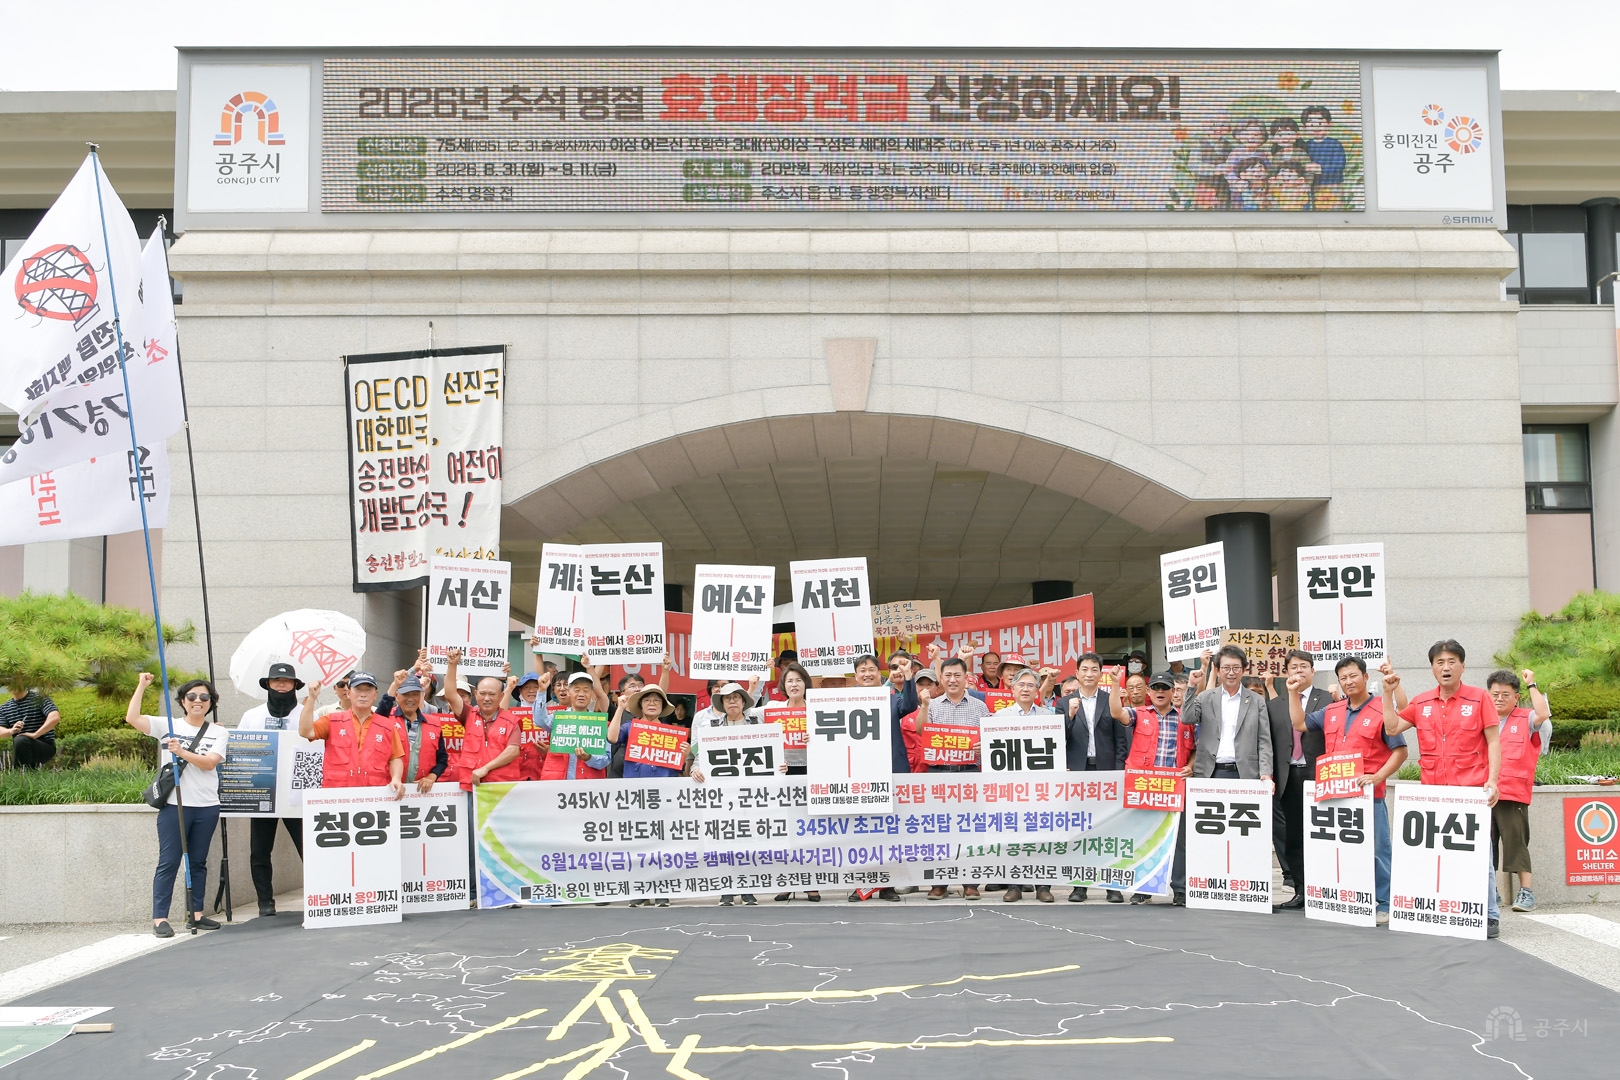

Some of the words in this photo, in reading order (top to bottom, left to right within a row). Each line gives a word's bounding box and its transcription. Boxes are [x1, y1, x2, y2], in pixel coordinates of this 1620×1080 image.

[359, 85, 489, 121] 2026년
[498, 84, 566, 121] 추석
[577, 85, 645, 121] 명절
[659, 74, 909, 122] 효행장려금
[924, 74, 1181, 122] 신청하세요!
[610, 138, 637, 152] 이상
[641, 138, 682, 152] 어르신
[904, 138, 945, 152] 세대주
[1382, 133, 1438, 149] 흥미진진
[216, 152, 280, 176] 공주시
[761, 162, 810, 176] 20만원
[1413, 153, 1455, 174] 공주
[217, 177, 256, 186] GONGJU
[354, 375, 429, 413] OECD
[444, 368, 500, 406] 선진국
[358, 453, 430, 493] 송전방식
[447, 445, 503, 485] 여전히
[590, 564, 655, 596] 논산
[1168, 562, 1218, 599] 용인
[1307, 565, 1376, 600] 천안
[436, 578, 502, 610] 서산
[702, 584, 766, 614] 예산
[802, 577, 860, 609] 서천
[1422, 706, 1432, 718] 투
[1460, 704, 1473, 717] 쟁
[556, 724, 576, 735] 충남은
[579, 726, 602, 736] 에너지
[815, 708, 881, 742] 부여
[552, 736, 580, 748] 식민지가
[582, 738, 605, 748] 아니다
[638, 731, 678, 750] 송전탑
[930, 734, 971, 750] 송전탑
[628, 744, 682, 766] 결사반대
[707, 745, 774, 777] 당진
[924, 748, 975, 762] 결사반대
[990, 738, 1057, 772] 해남
[1320, 762, 1356, 781] 송전탑
[810, 782, 849, 794] 해남에서
[851, 782, 890, 794] 용인까지
[1134, 776, 1176, 792] 송전탑
[1316, 779, 1361, 798] 결사반대
[558, 792, 610, 810] 345kV
[615, 790, 662, 810] 신계룡
[676, 788, 724, 808] 신천안
[738, 786, 807, 808] 군산-신천
[893, 786, 926, 804] 전탑
[931, 784, 978, 804] 백지화
[983, 783, 1030, 804] 캠페인
[1036, 782, 1050, 802] 및
[1054, 781, 1118, 801] 기자회견
[811, 796, 832, 805] 이재명
[832, 795, 859, 804] 대통령은
[860, 794, 890, 804] 응답하라!
[1127, 792, 1182, 808] 결사반대
[314, 810, 390, 848] 청양
[582, 821, 613, 842] 용인
[618, 820, 665, 840] 반도체
[669, 820, 700, 840] 산단
[704, 820, 752, 840] 재검토
[756, 819, 788, 838] 하고
[796, 816, 849, 836] 345kV
[854, 815, 900, 835] 초고압
[905, 814, 952, 833] 송전탑
[956, 812, 1018, 832] 건설계획
[1024, 810, 1093, 831] 철회하라!
[1194, 800, 1261, 836] 공주
[1310, 806, 1364, 844] 보령
[1402, 810, 1480, 852] 아산
[541, 850, 633, 872] 8월14일(금)
[637, 849, 698, 870] 7시30분
[703, 845, 843, 868] 캠페인(전막사거리)
[848, 844, 884, 864] 09시
[888, 842, 951, 864] 차량행진
[966, 842, 1002, 858] 11시
[1006, 838, 1068, 857] 공주시청
[1072, 836, 1135, 859] 기자회견
[1576, 848, 1618, 861] 대피소
[566, 883, 590, 898] 용인
[594, 880, 630, 896] 반도체
[634, 878, 682, 895] 국가산단
[685, 876, 734, 892] 재검토와
[736, 874, 772, 890] 초고압
[776, 872, 812, 888] 송전탑
[815, 872, 840, 886] 반대
[842, 870, 891, 884] 전국행동
[970, 865, 1005, 880] 공주시
[1010, 866, 1058, 880] 송전선로
[1061, 864, 1098, 882] 백지화
[1100, 868, 1136, 886] 대책위
[308, 892, 352, 907] 해남에서
[354, 890, 398, 904] 용인까지
[1393, 894, 1436, 912] 해남에서
[1438, 900, 1483, 916] 용인까지
[308, 908, 332, 918] 이재명
[334, 906, 364, 916] 대통령은
[366, 904, 398, 915] 응답하라!
[1393, 910, 1415, 921] 이재명
[1417, 912, 1447, 925] 대통령은
[1449, 915, 1483, 928] 응답하라!
